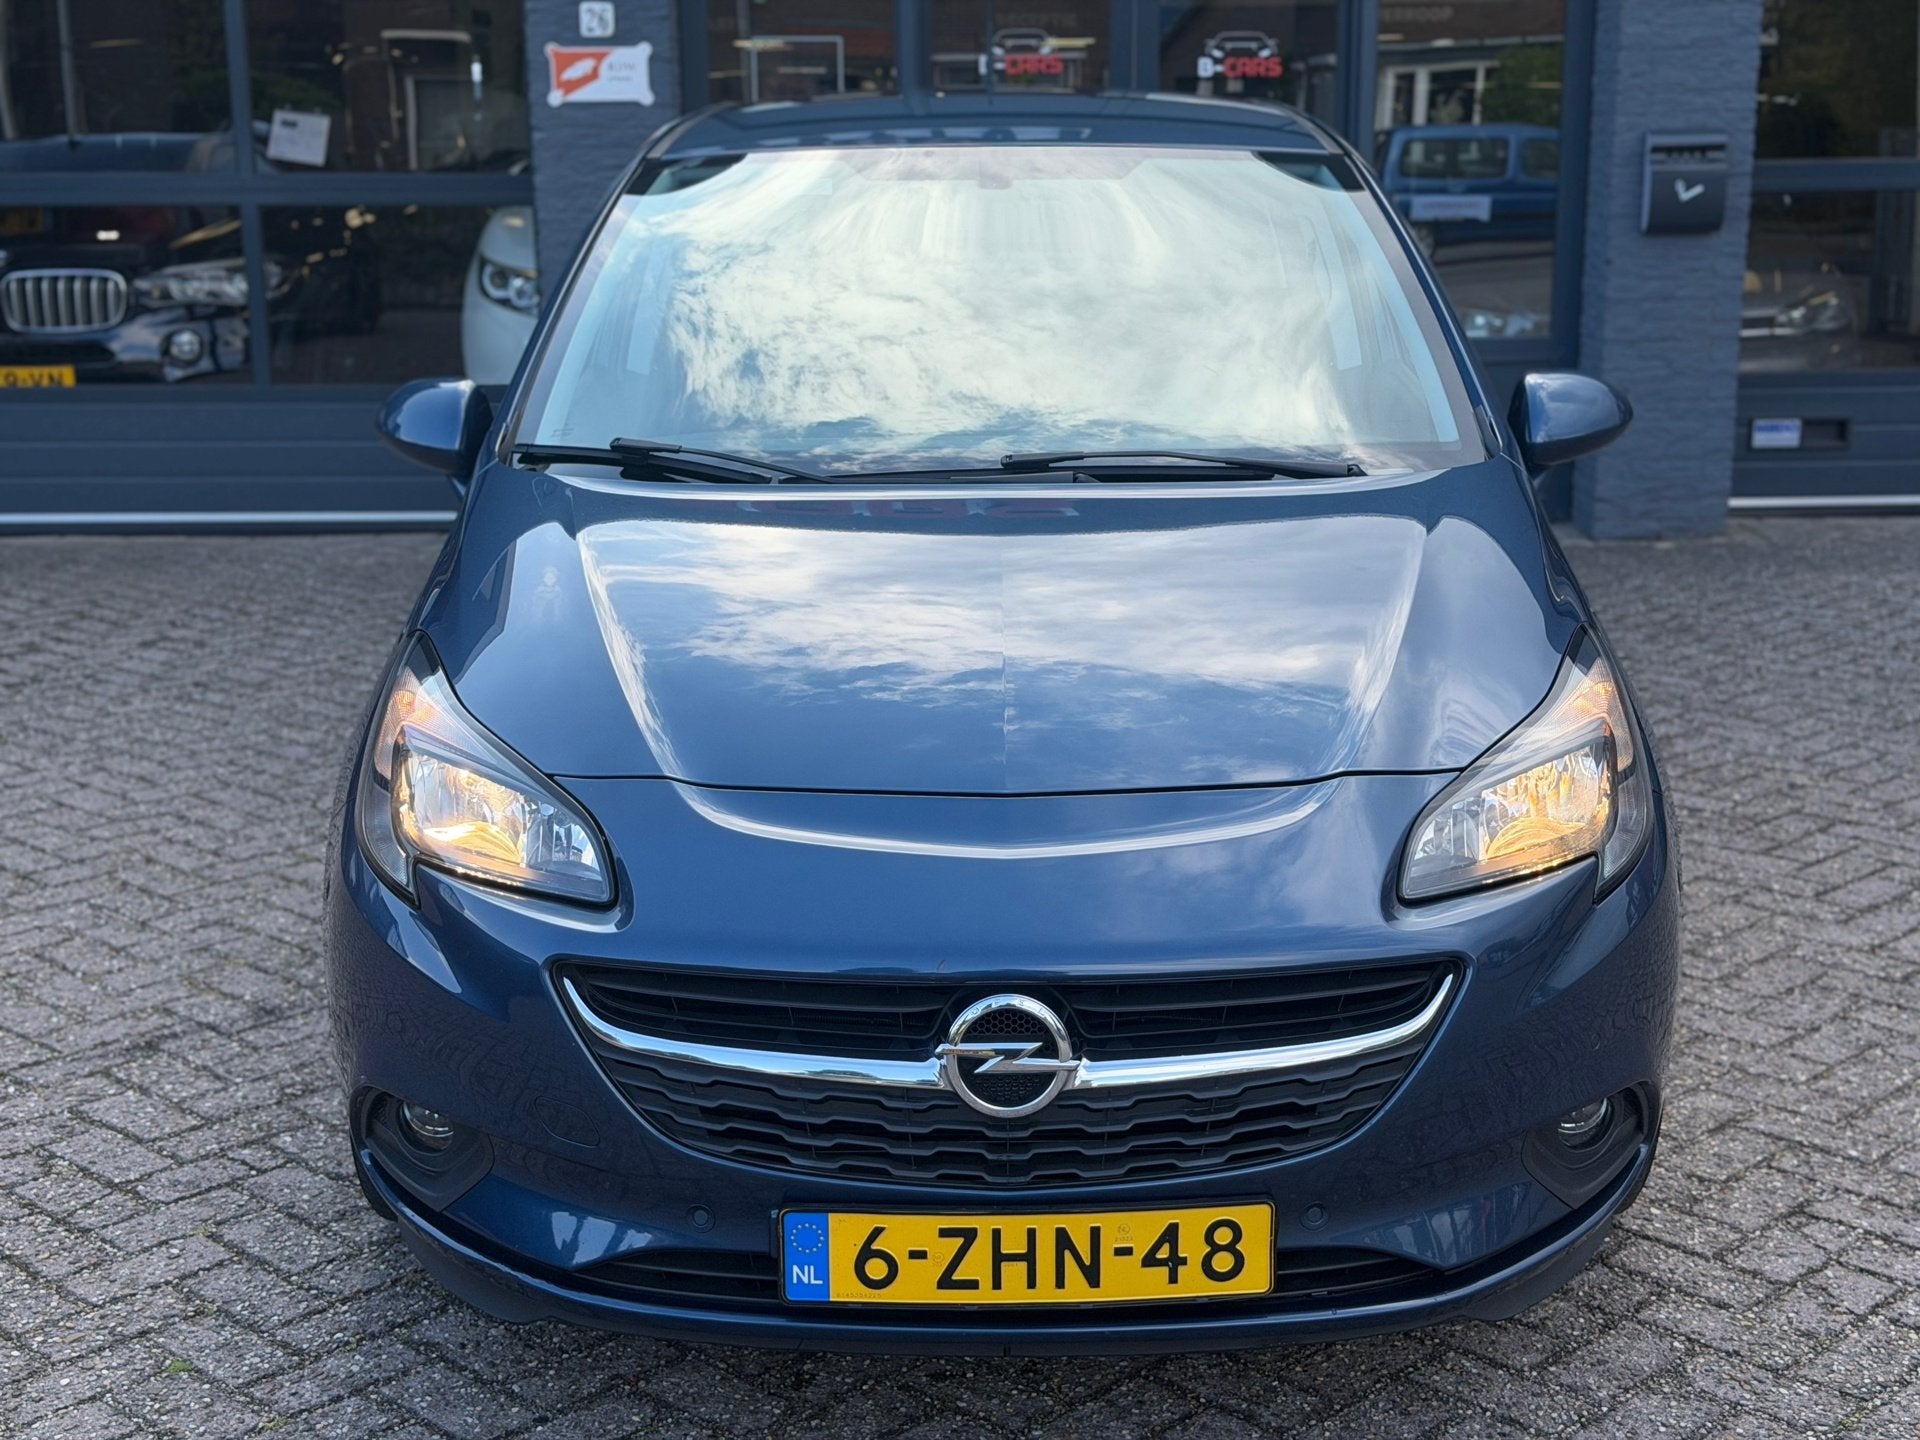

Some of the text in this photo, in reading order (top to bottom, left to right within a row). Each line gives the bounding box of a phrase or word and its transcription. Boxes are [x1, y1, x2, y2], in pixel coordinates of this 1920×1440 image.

[1197, 56, 1284, 78] B-CARS
[854, 1218, 1245, 1291] 6-ZHN-48
[792, 1264, 823, 1285] NL
